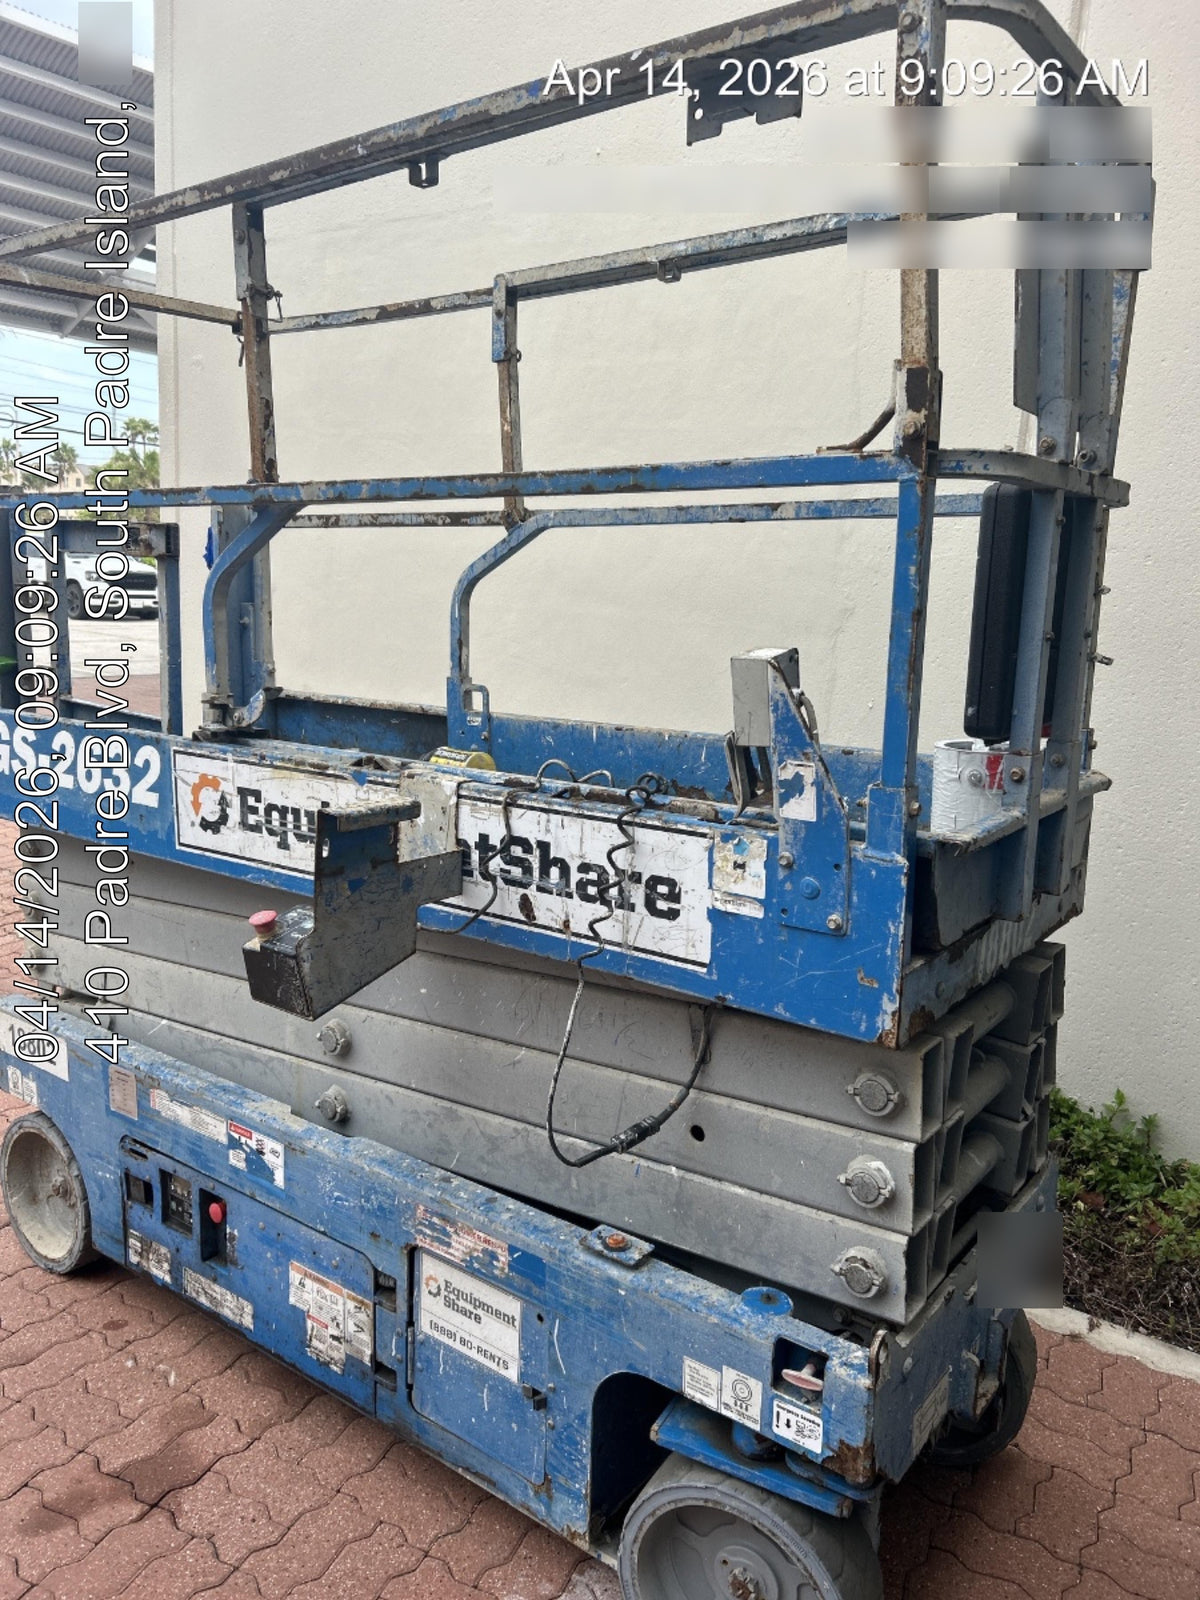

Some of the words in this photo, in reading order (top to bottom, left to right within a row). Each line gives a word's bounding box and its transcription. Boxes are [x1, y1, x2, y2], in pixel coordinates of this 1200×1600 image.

[443, 1279, 517, 1329] Equipment
[443, 1295, 482, 1325] Share
[429, 1319, 457, 1342] (888)
